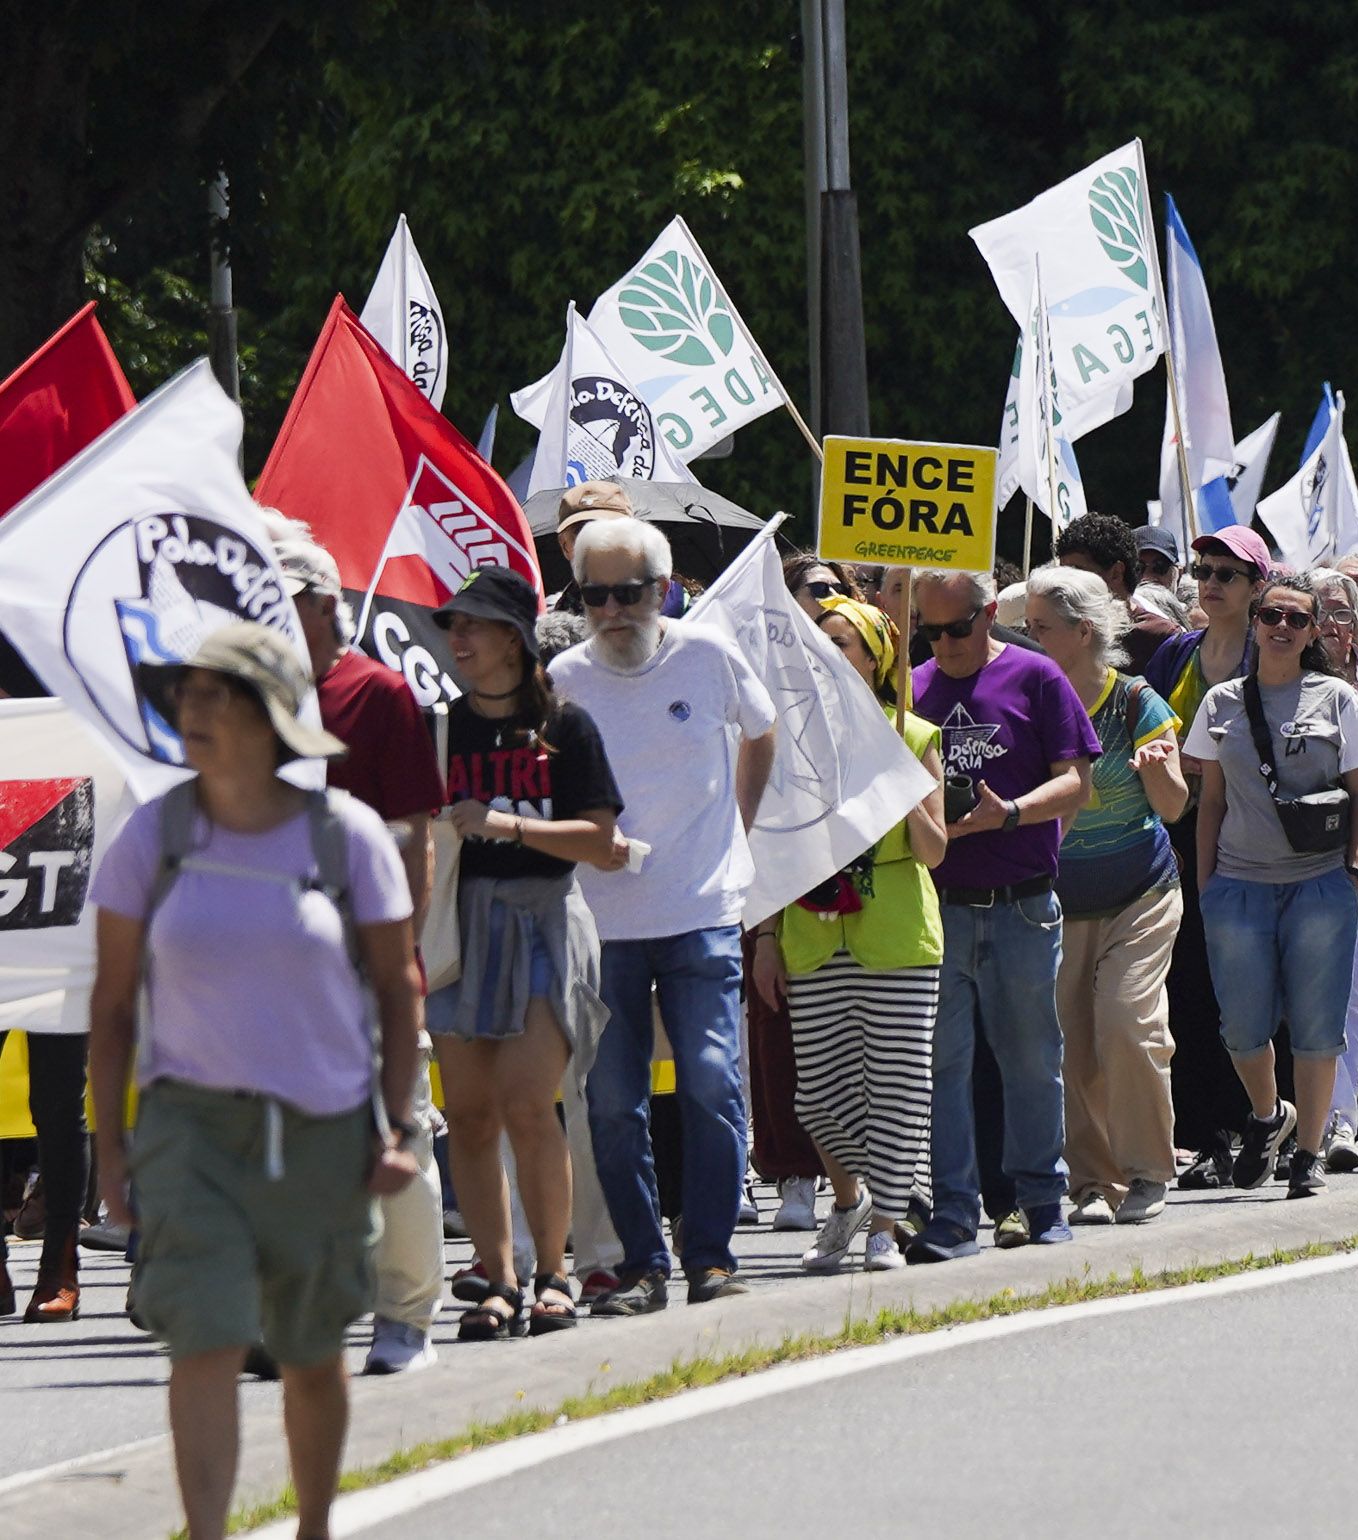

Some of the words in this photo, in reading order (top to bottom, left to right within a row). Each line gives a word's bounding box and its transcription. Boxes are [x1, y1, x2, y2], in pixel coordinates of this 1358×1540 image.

[844, 450, 975, 494] ENCE
[842, 489, 975, 537] FÓRA
[854, 541, 958, 563] GREENPEACE
[948, 737, 1009, 761] Defensa
[449, 747, 552, 802] ALTRI
